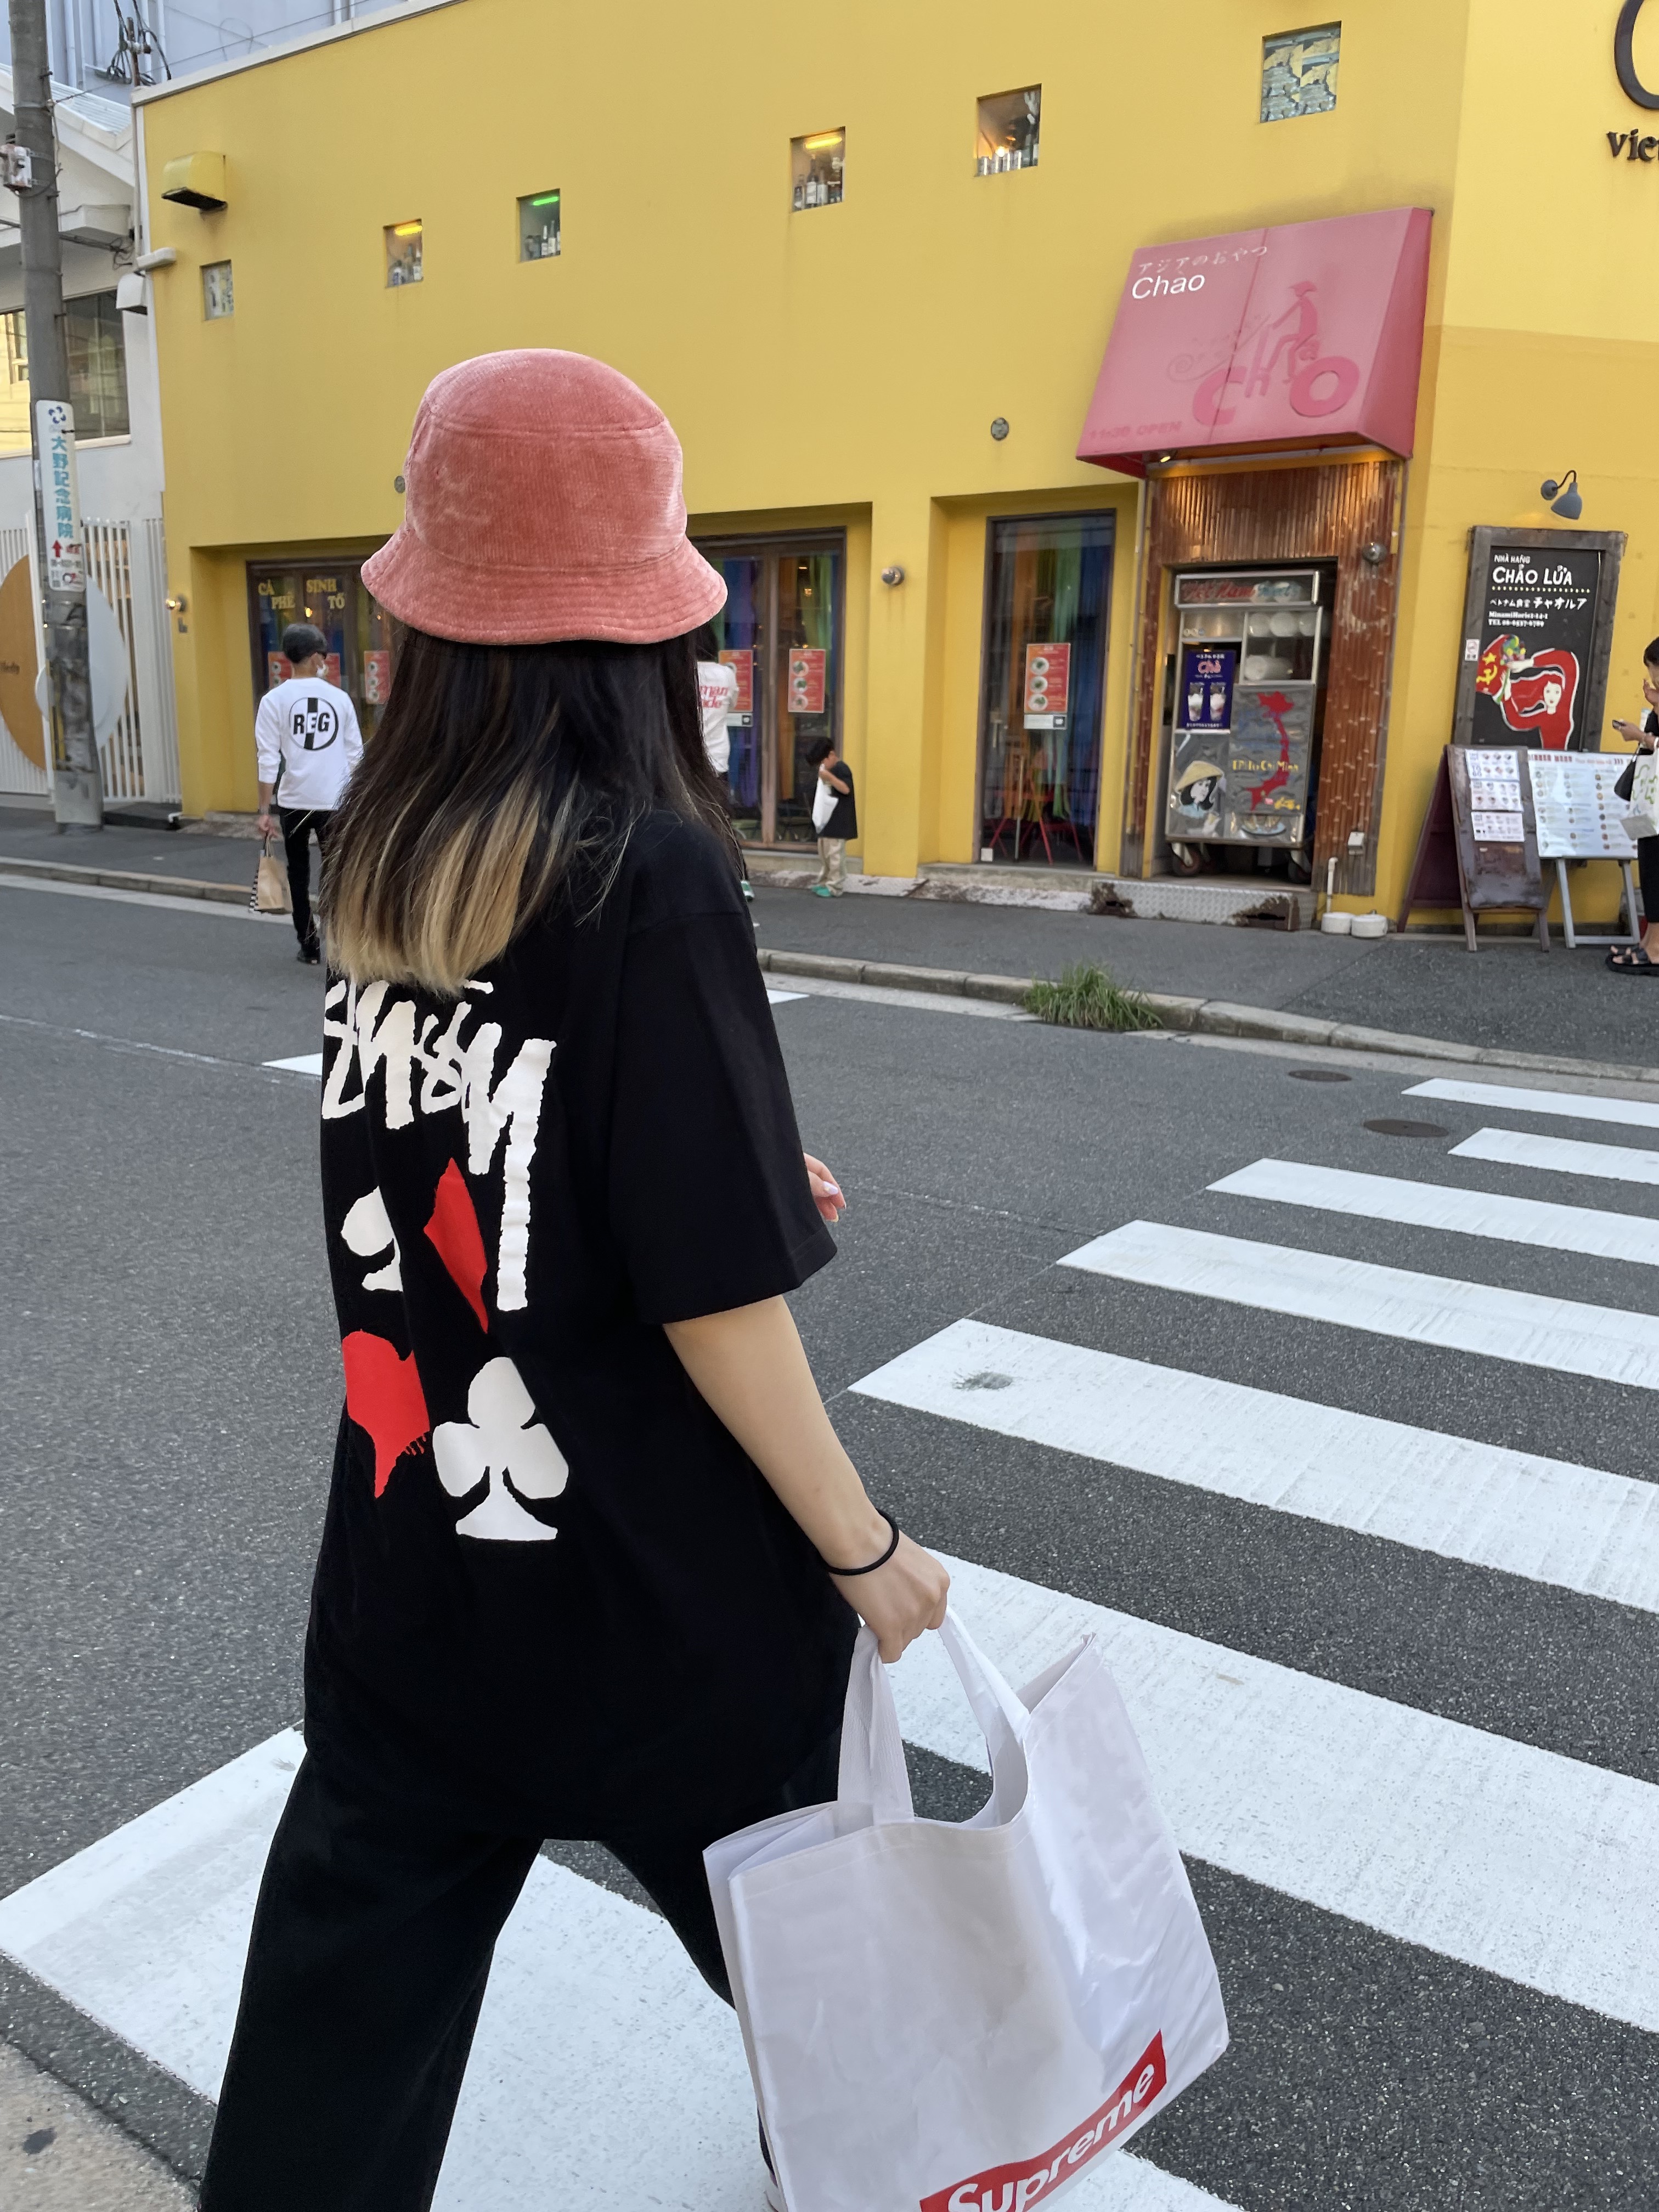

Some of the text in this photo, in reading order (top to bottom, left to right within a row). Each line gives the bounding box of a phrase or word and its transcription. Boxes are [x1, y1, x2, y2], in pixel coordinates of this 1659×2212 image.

[1606, 129, 1659, 162] vie
[1132, 274, 1205, 299] Chao
[294, 713, 330, 735] REG
[947, 2063, 1155, 2212] Supreme
